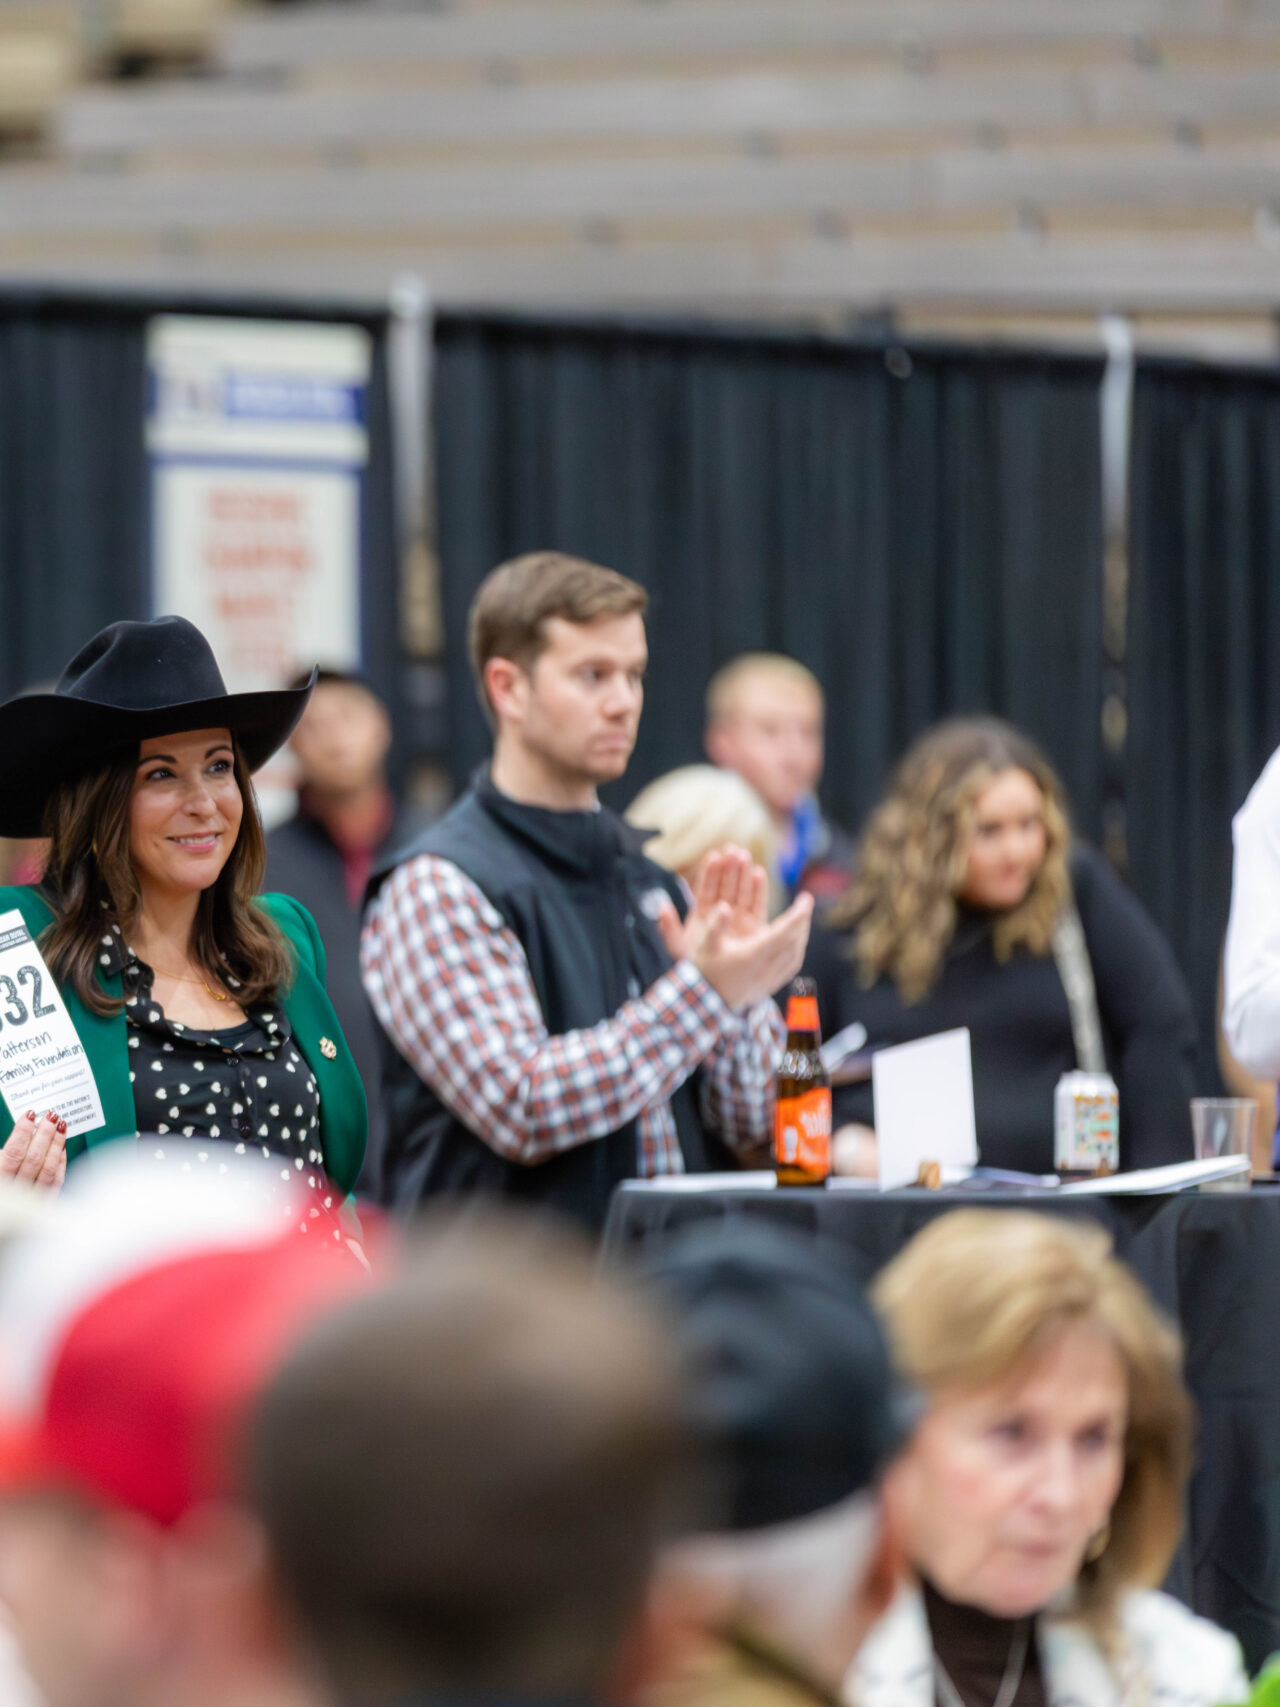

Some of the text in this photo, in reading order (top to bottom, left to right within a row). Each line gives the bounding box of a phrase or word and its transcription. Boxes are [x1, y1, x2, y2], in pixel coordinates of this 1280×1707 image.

[10, 928, 26, 940] ROYAL
[32, 1044, 84, 1069] Foundation
[10, 1089, 29, 1101] Thank
[31, 1086, 41, 1095] you
[41, 1081, 51, 1092] for
